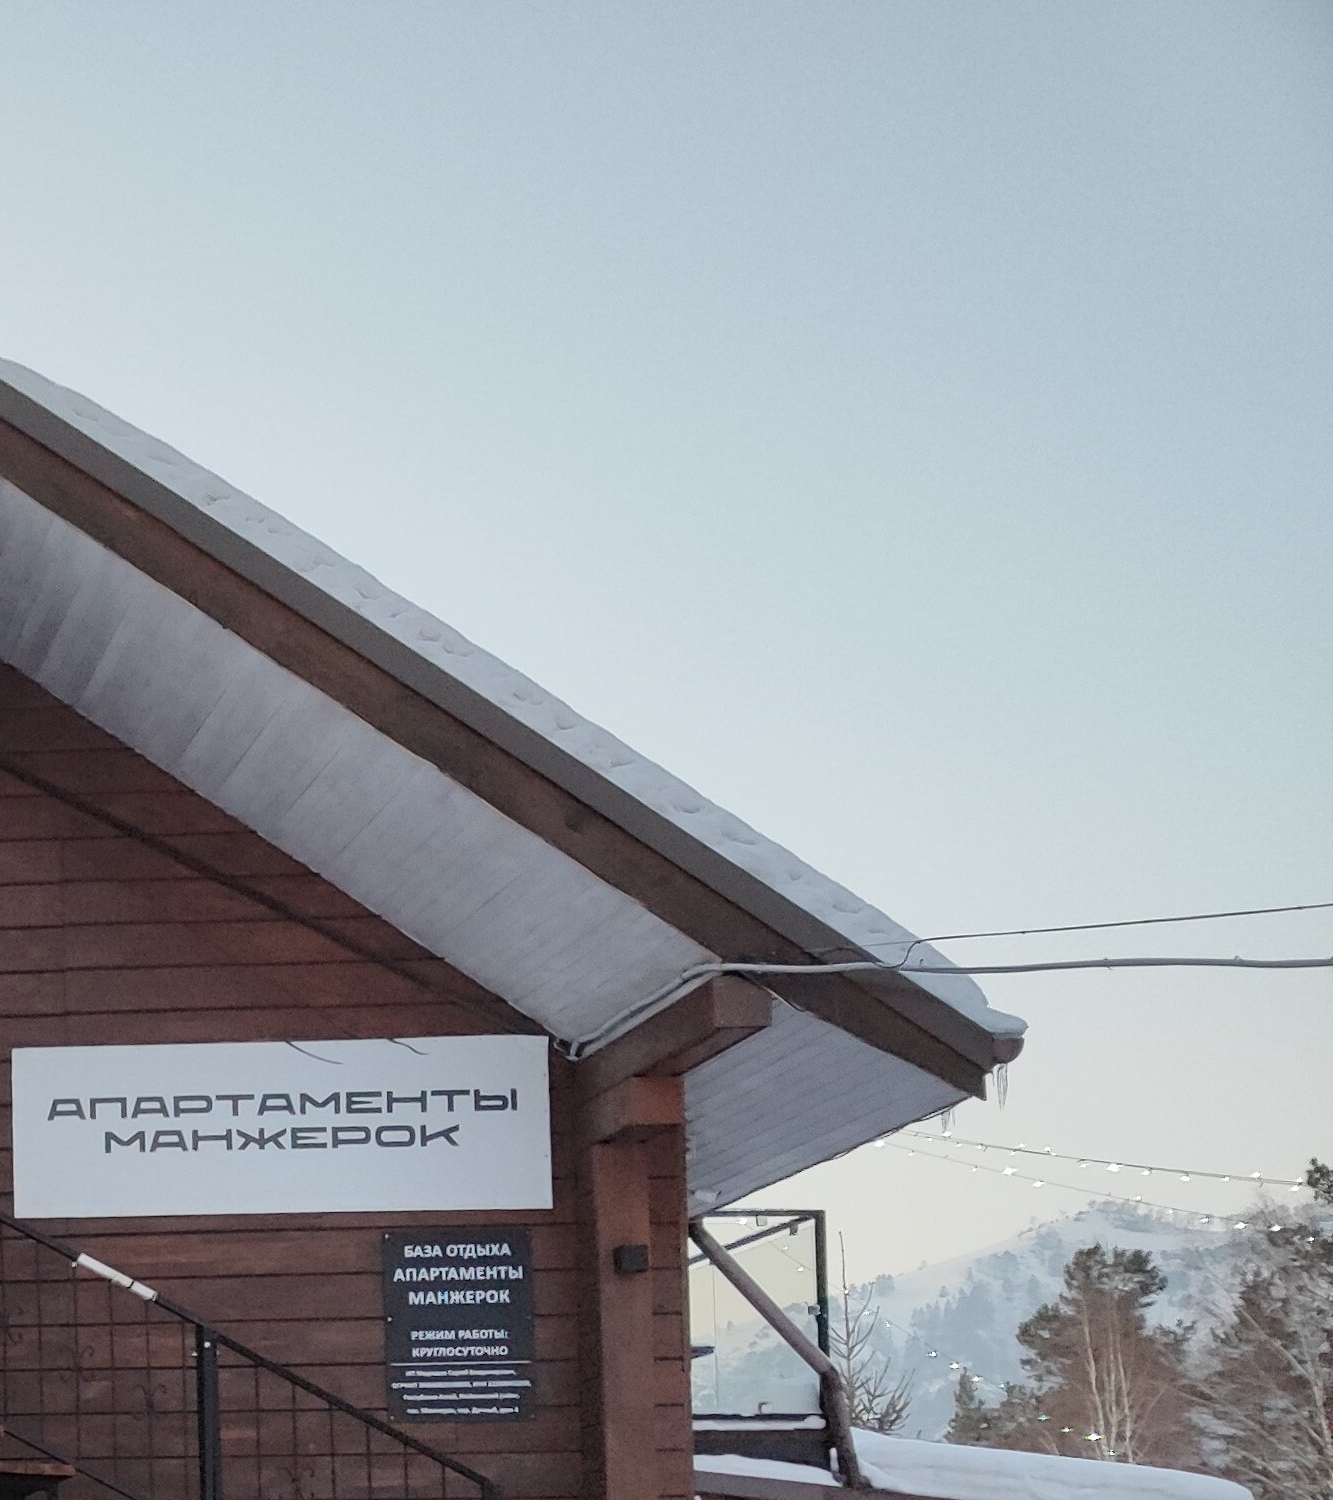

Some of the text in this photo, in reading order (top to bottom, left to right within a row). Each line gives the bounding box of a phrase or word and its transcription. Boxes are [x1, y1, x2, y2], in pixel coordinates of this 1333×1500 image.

[47, 1088, 518, 1121] АПАРТАМЕНТЫ
[104, 1124, 460, 1153] МАНЖЕРОК
[403, 1243, 512, 1259] БАЗА ОТДЫХА
[393, 1265, 524, 1282] АПАРТАМЕНТЫ
[408, 1289, 511, 1305] МАНЖЕРОК
[410, 1330, 456, 1340] РЕЖИМ
[411, 1345, 509, 1358] КРУГЛОСУТОЧНО
